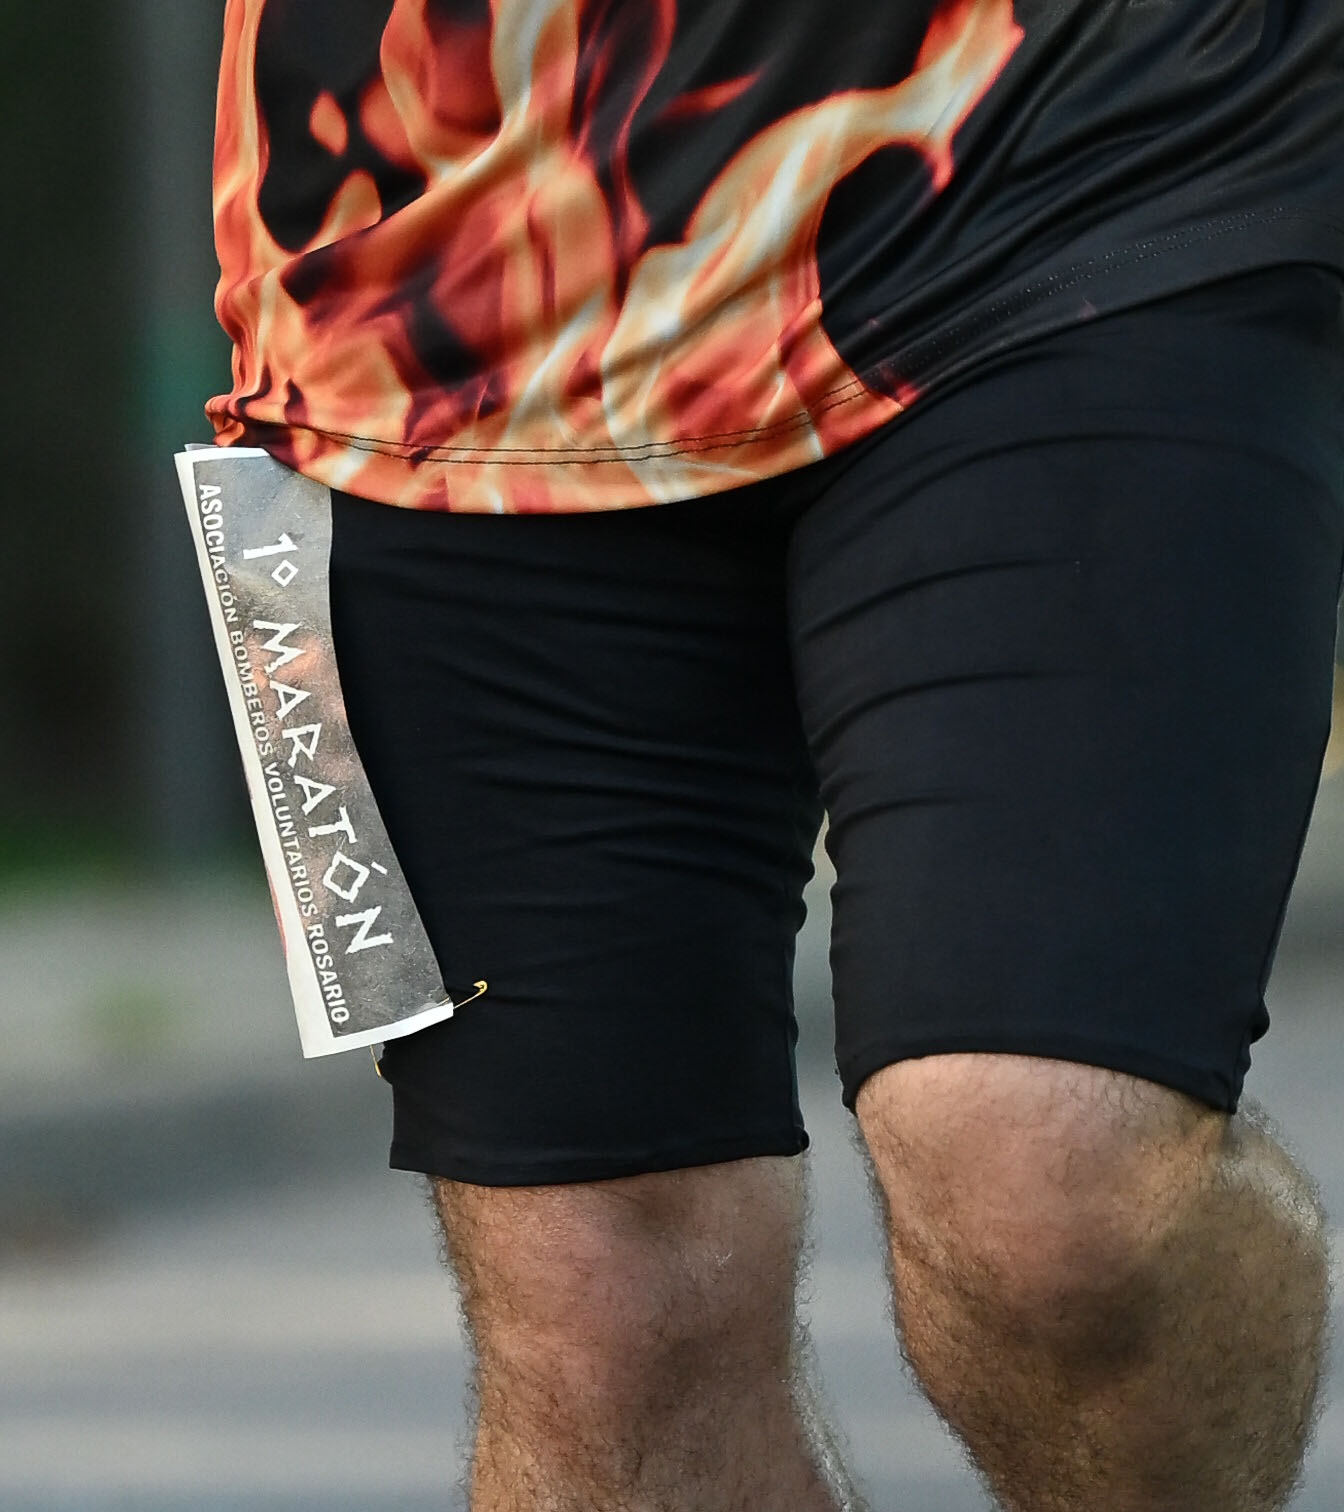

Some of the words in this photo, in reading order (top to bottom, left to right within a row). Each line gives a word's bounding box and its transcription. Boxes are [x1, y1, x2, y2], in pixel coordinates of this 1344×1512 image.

[199, 484, 238, 623] ASOCIACIÓN
[230, 630, 273, 756] BOMBEROS
[264, 762, 317, 917] VOLUNTARIOS
[307, 924, 350, 1024] ROSARIO
[253, 619, 394, 954] MARATÓN
